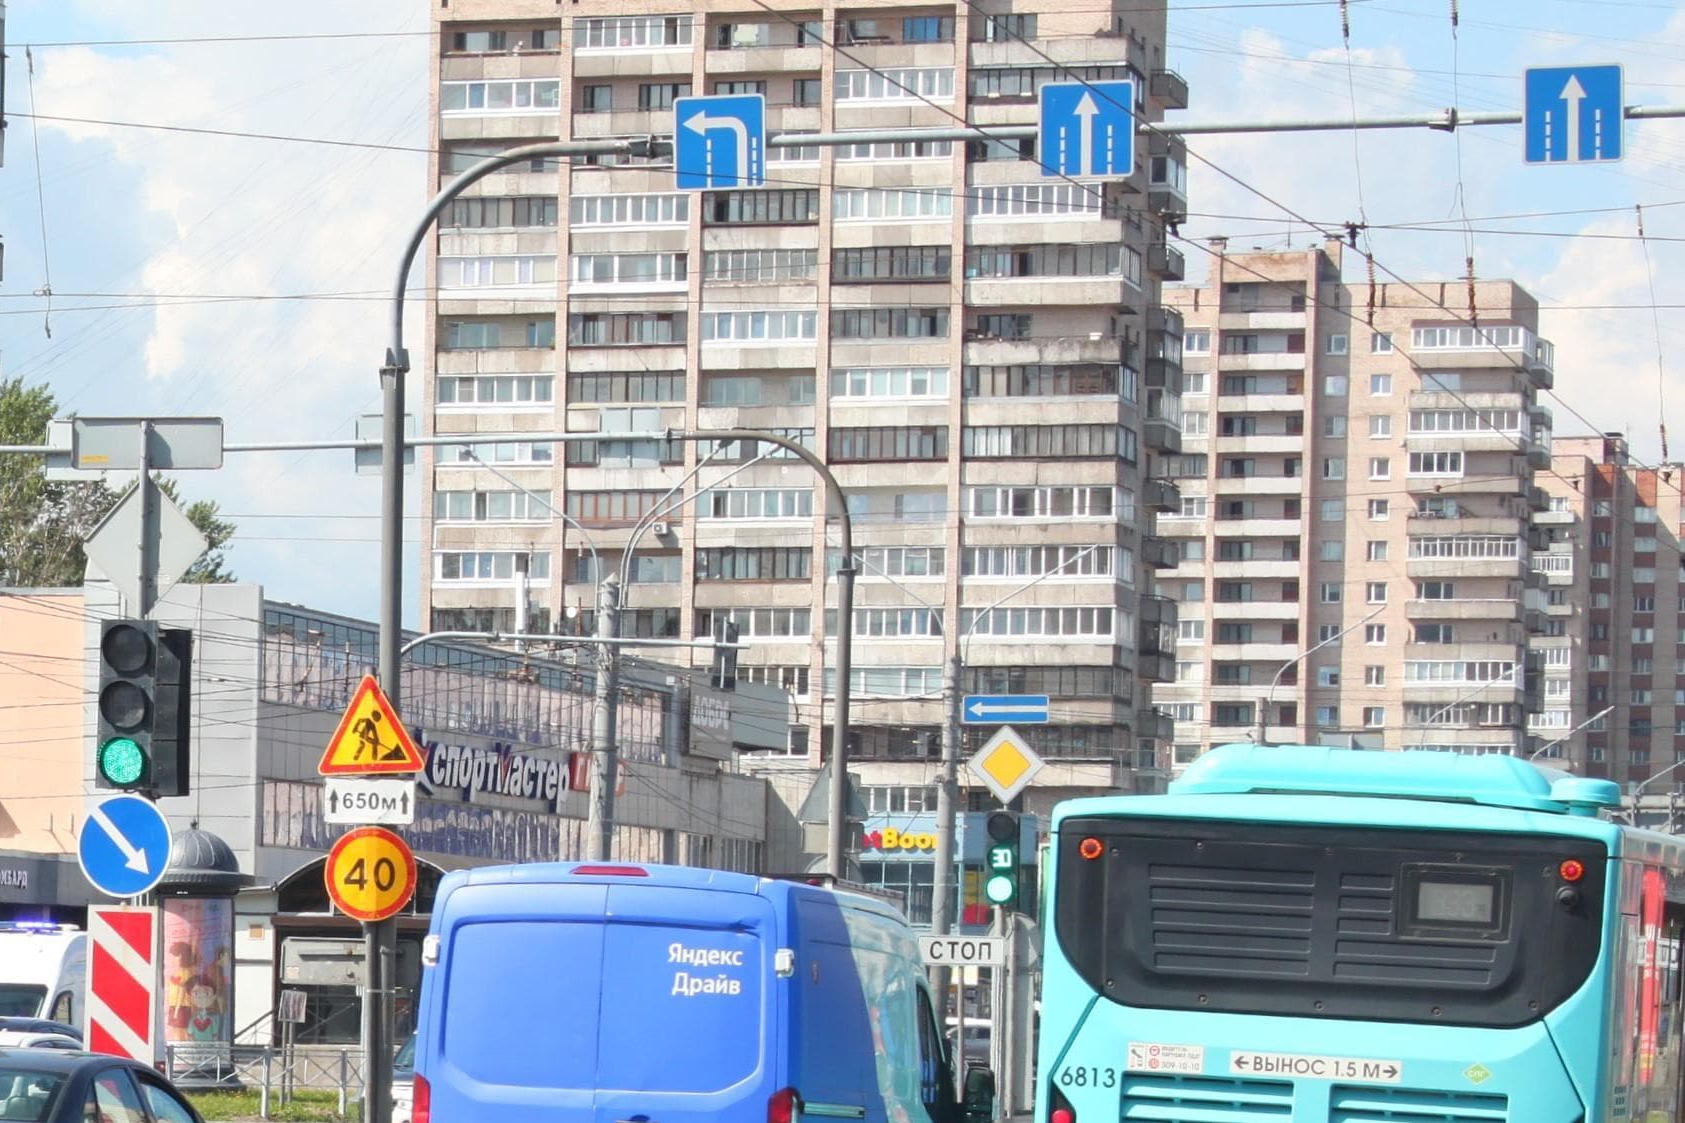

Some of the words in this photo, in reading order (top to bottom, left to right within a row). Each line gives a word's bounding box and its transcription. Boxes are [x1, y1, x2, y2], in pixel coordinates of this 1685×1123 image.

[343, 857, 396, 892] 40
[667, 942, 744, 967] Яндекс
[929, 941, 992, 961] СТОП
[671, 972, 741, 996] Драйв
[1060, 1065, 1116, 1089] 6813
[1252, 1055, 1326, 1075] ВЫНОС
[1333, 1060, 1357, 1077] 1.5
[1363, 1063, 1380, 1078] М
